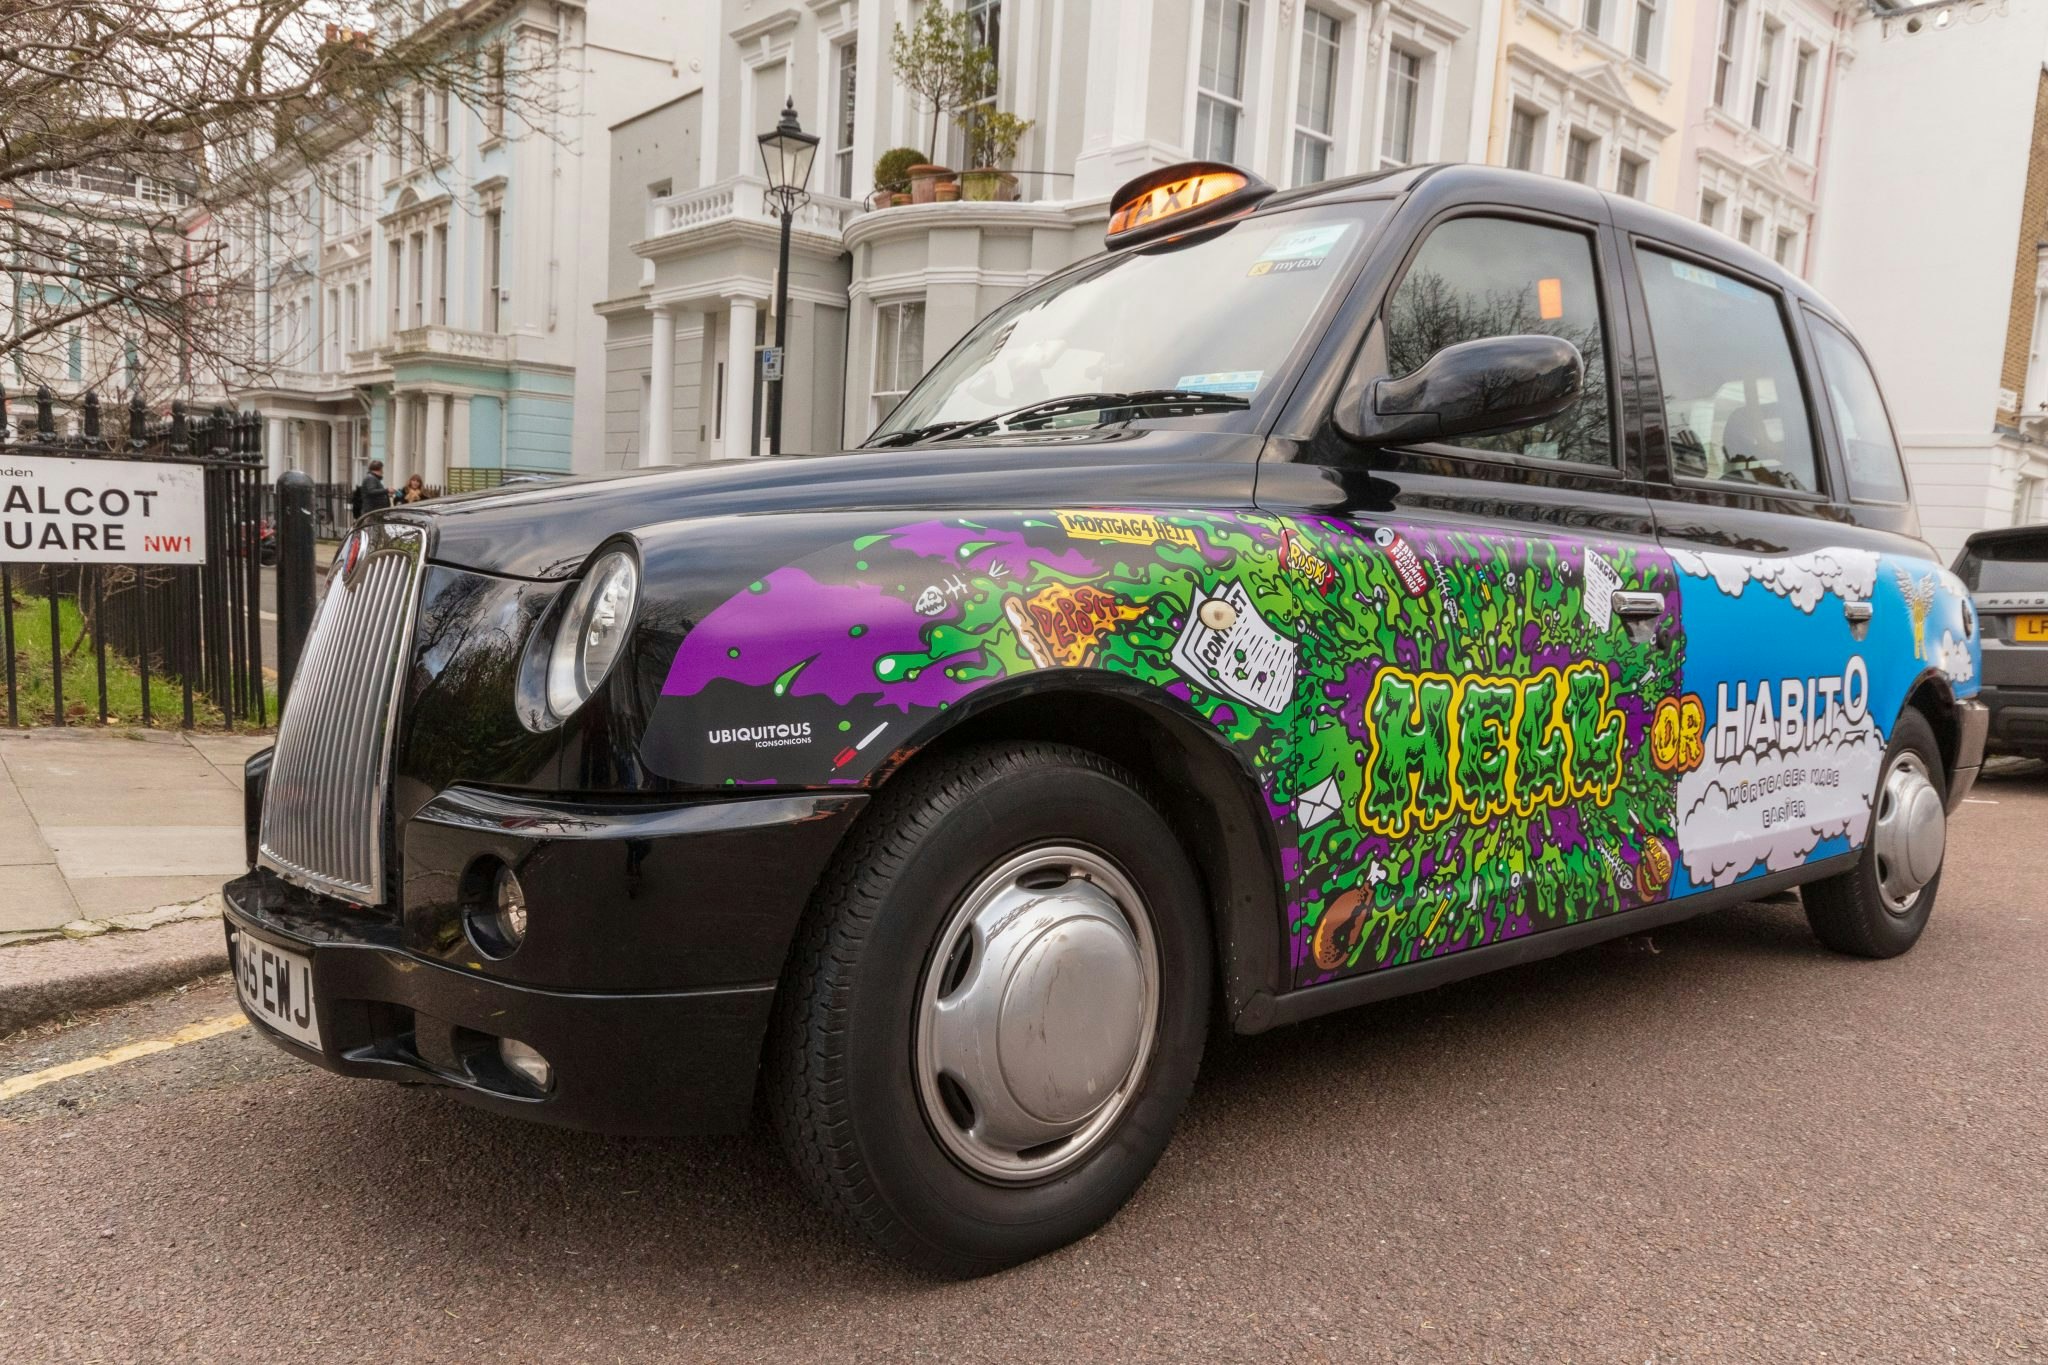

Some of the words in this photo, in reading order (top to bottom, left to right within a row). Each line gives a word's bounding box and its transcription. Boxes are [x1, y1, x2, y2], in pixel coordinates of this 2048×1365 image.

[1117, 178, 1204, 230] TAXI
[1274, 257, 1326, 272] mytaxi
[4, 521, 126, 551] UARE
[144, 534, 192, 553] NW1
[1396, 538, 1422, 570] EARLY
[1290, 542, 1326, 583] RISK
[1390, 546, 1427, 587] REPAYMENT
[1588, 551, 1618, 585] JARGON
[1029, 588, 1121, 650] DEPOSIT
[708, 722, 812, 744] UBIQUITOUS
[755, 736, 812, 748] ICONSONICONS
[1360, 661, 1625, 837] HELL
[1652, 693, 1705, 771] OR
[1714, 655, 1869, 763] HABITO
[1729, 768, 1806, 806] MORTGAGES
[1810, 768, 1839, 788] MADE
[1762, 799, 1806, 829] EASIER
[261, 949, 311, 1030] EWJ
